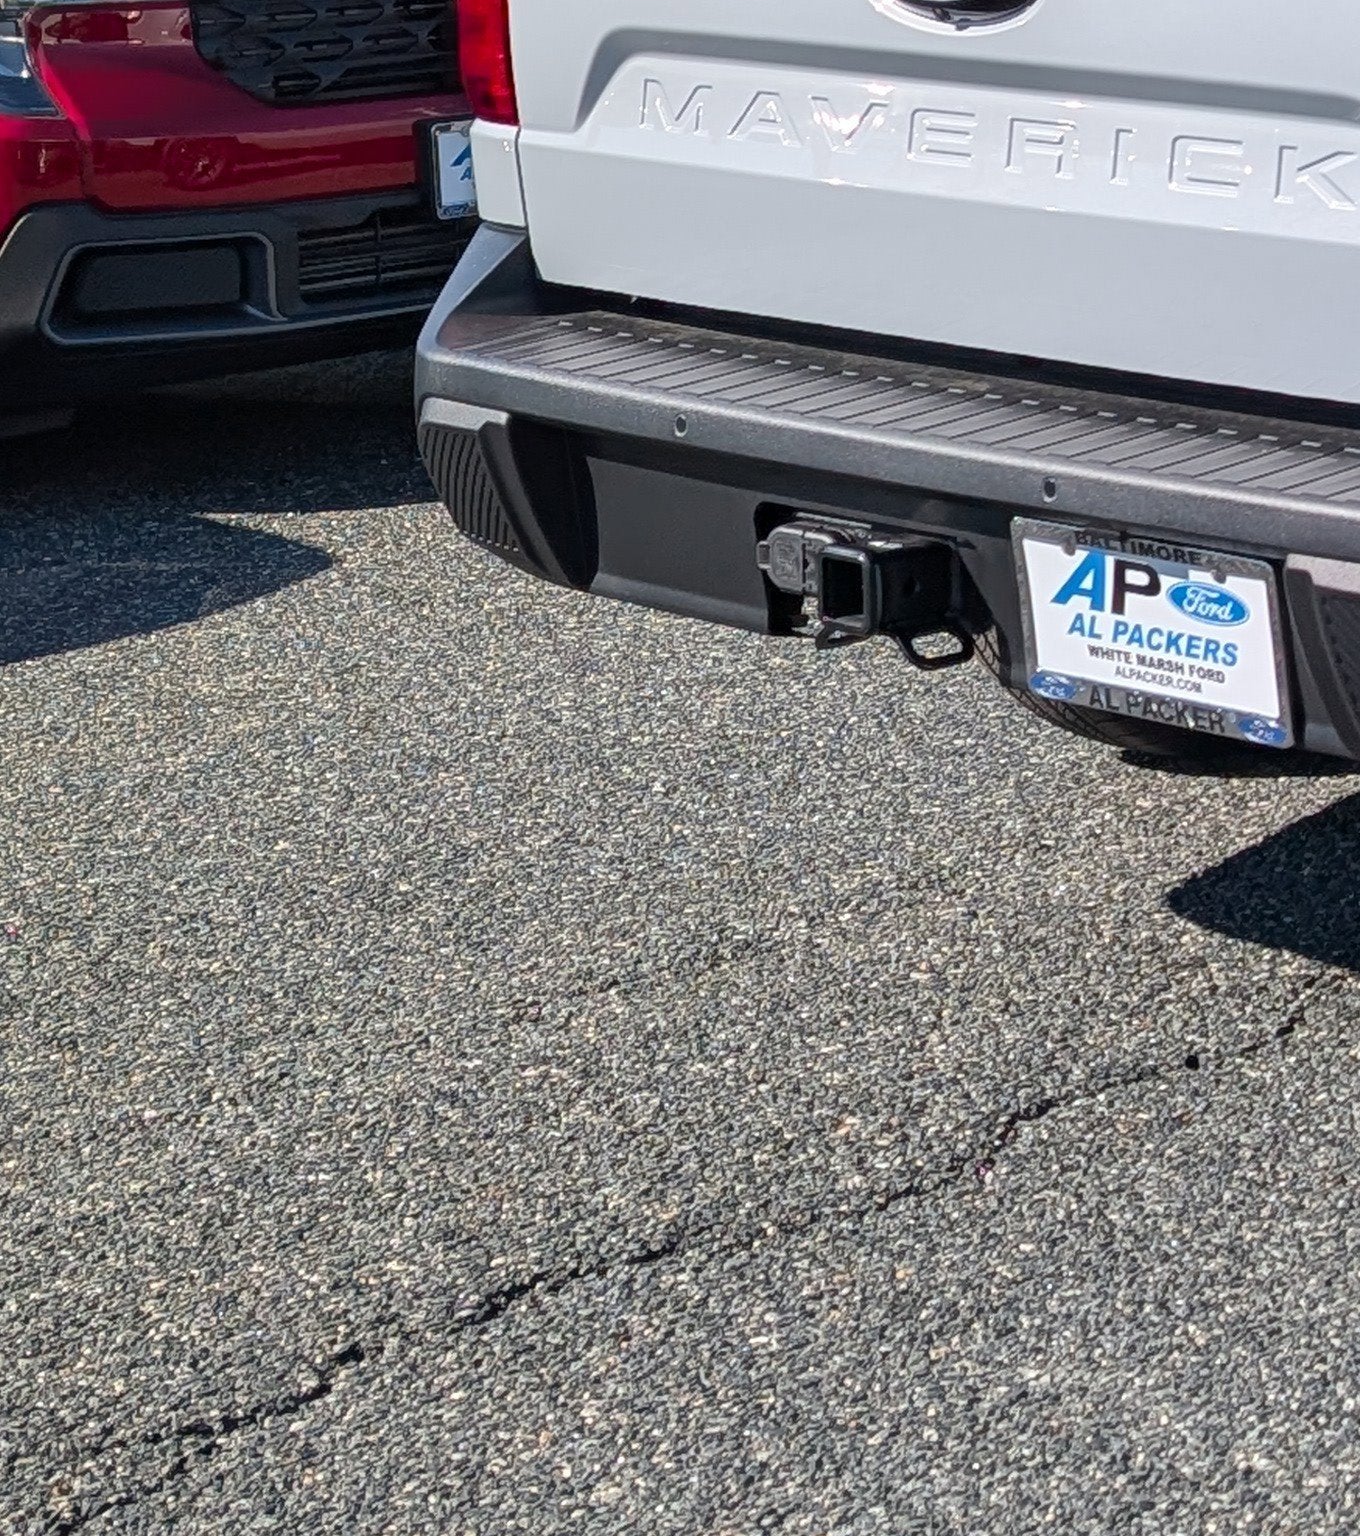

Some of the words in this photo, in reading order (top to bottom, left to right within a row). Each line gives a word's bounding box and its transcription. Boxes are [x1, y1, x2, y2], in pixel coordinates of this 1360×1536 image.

[638, 77, 1358, 211] MAVERICK
[1050, 549, 1162, 616] AP
[1182, 585, 1234, 621] Ford
[1067, 612, 1103, 640] AL
[1111, 619, 1239, 667] PACKERS
[1086, 643, 1134, 665] WHITE
[1135, 652, 1186, 676] MARSH
[1188, 663, 1227, 685] FORD
[1088, 684, 1120, 712] AL
[1125, 692, 1227, 735] PACKER
